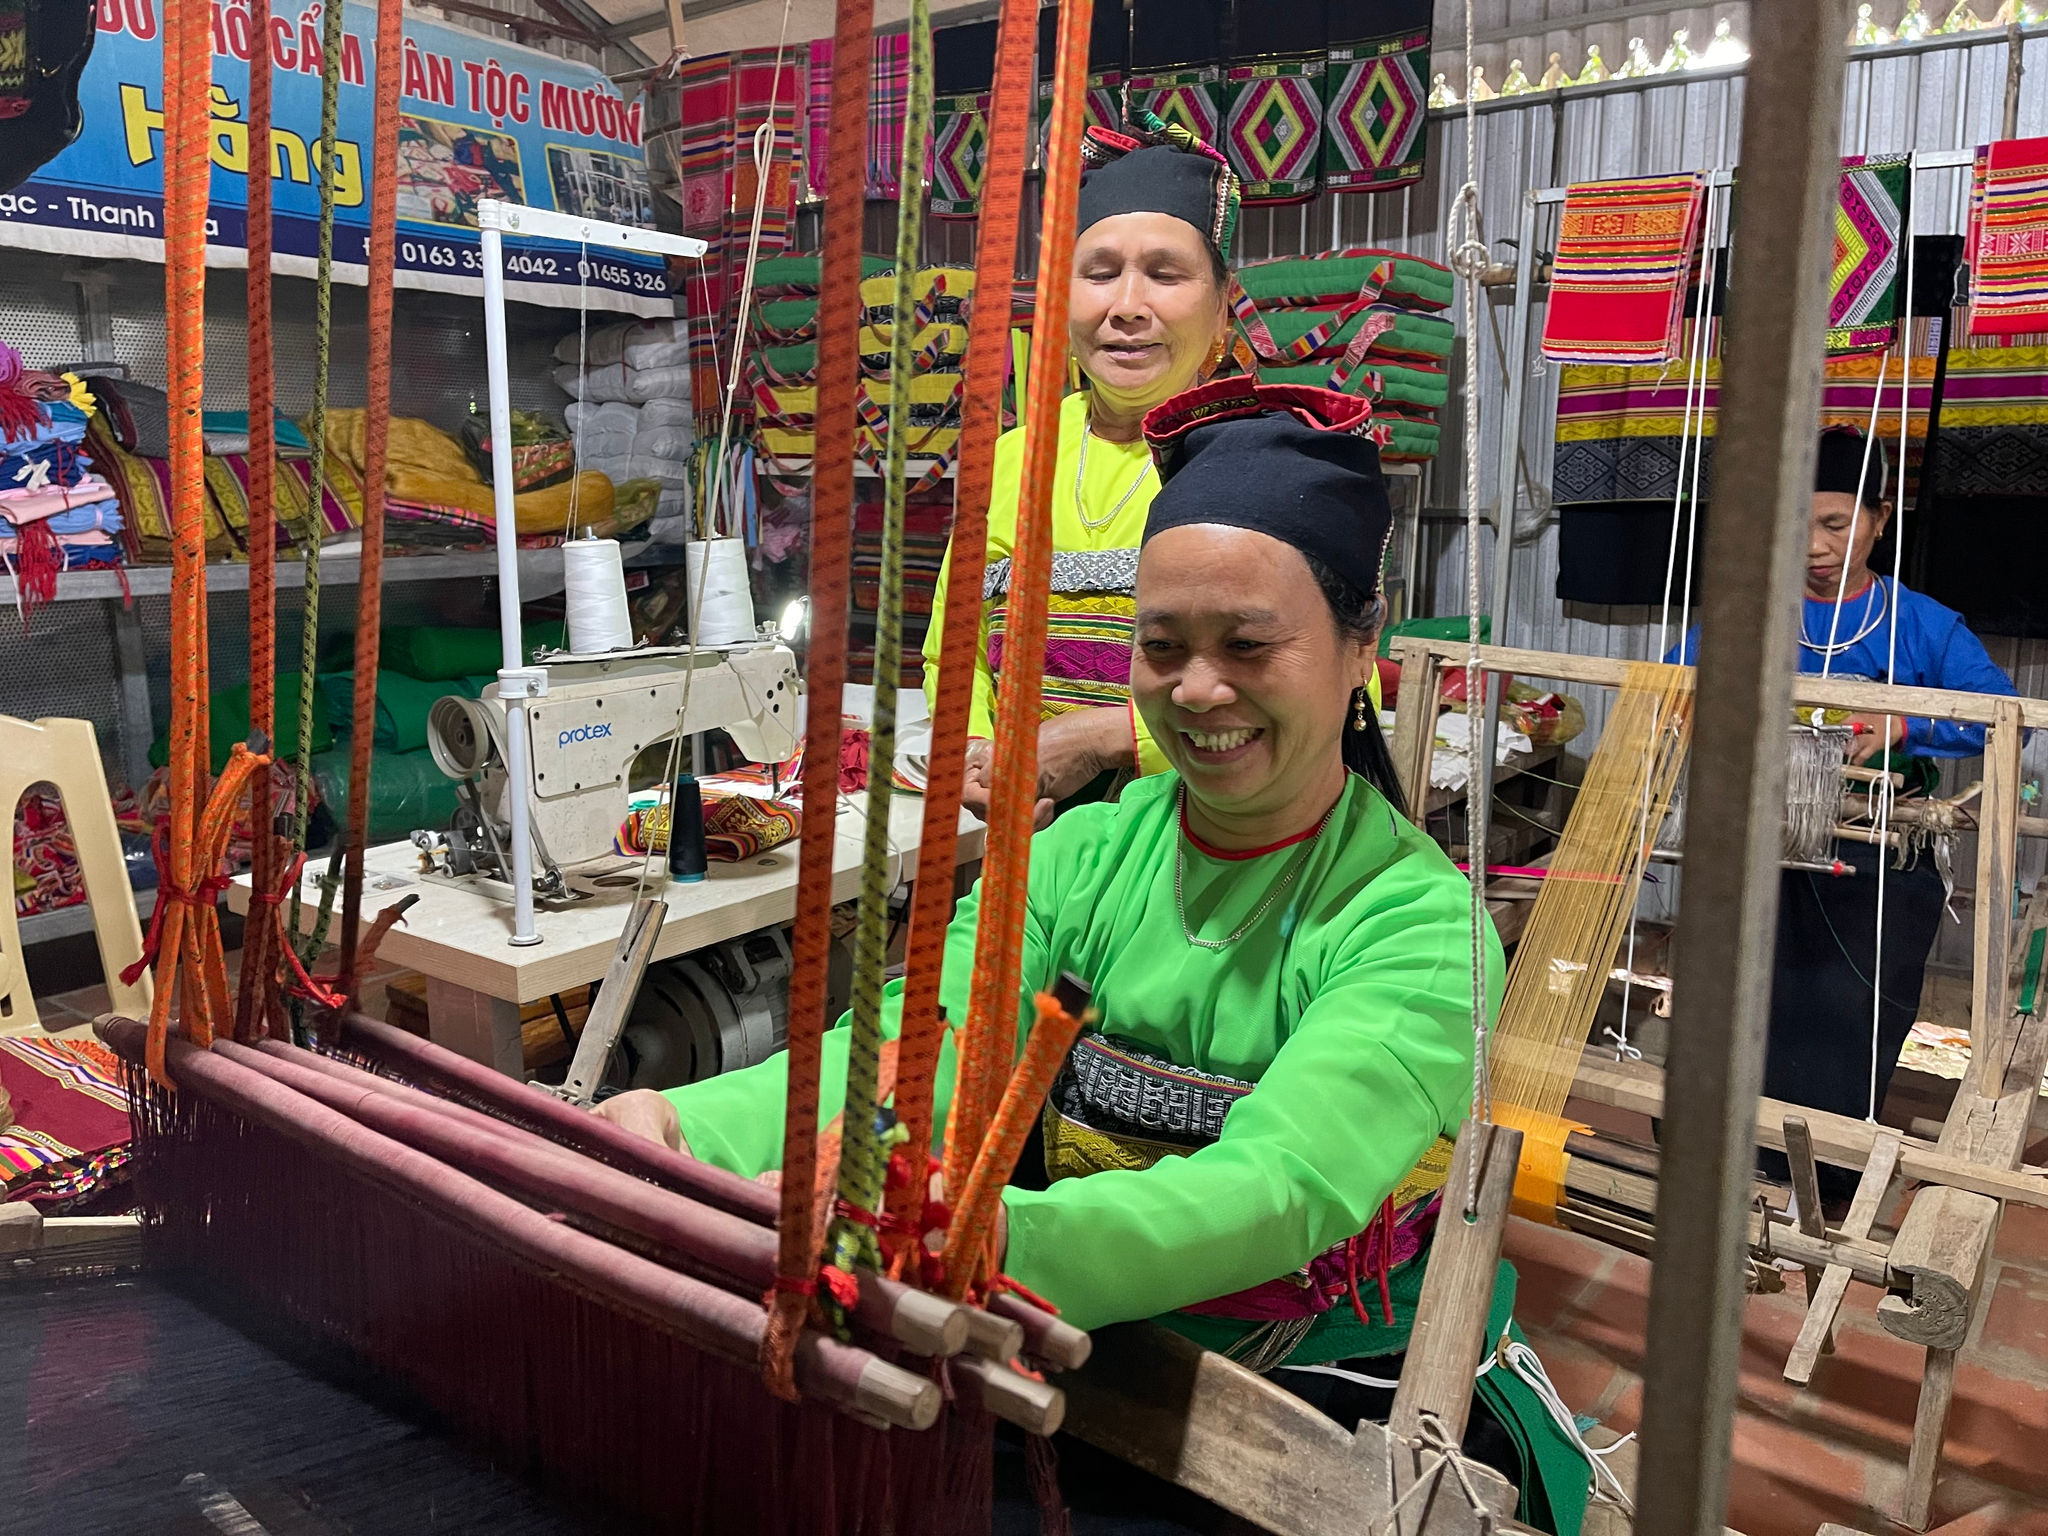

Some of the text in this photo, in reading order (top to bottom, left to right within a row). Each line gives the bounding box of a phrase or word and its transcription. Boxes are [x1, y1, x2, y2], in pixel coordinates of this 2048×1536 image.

[271, 3, 365, 86] CẨM
[374, 37, 455, 107] ÂN
[463, 58, 529, 129] TỘC
[119, 82, 365, 208] Hằng
[67, 196, 155, 229] Thanh
[401, 242, 456, 267] 0163
[507, 255, 558, 276] 4042
[577, 260, 630, 286] 01655
[633, 271, 666, 292] 326
[559, 722, 612, 749] protex
